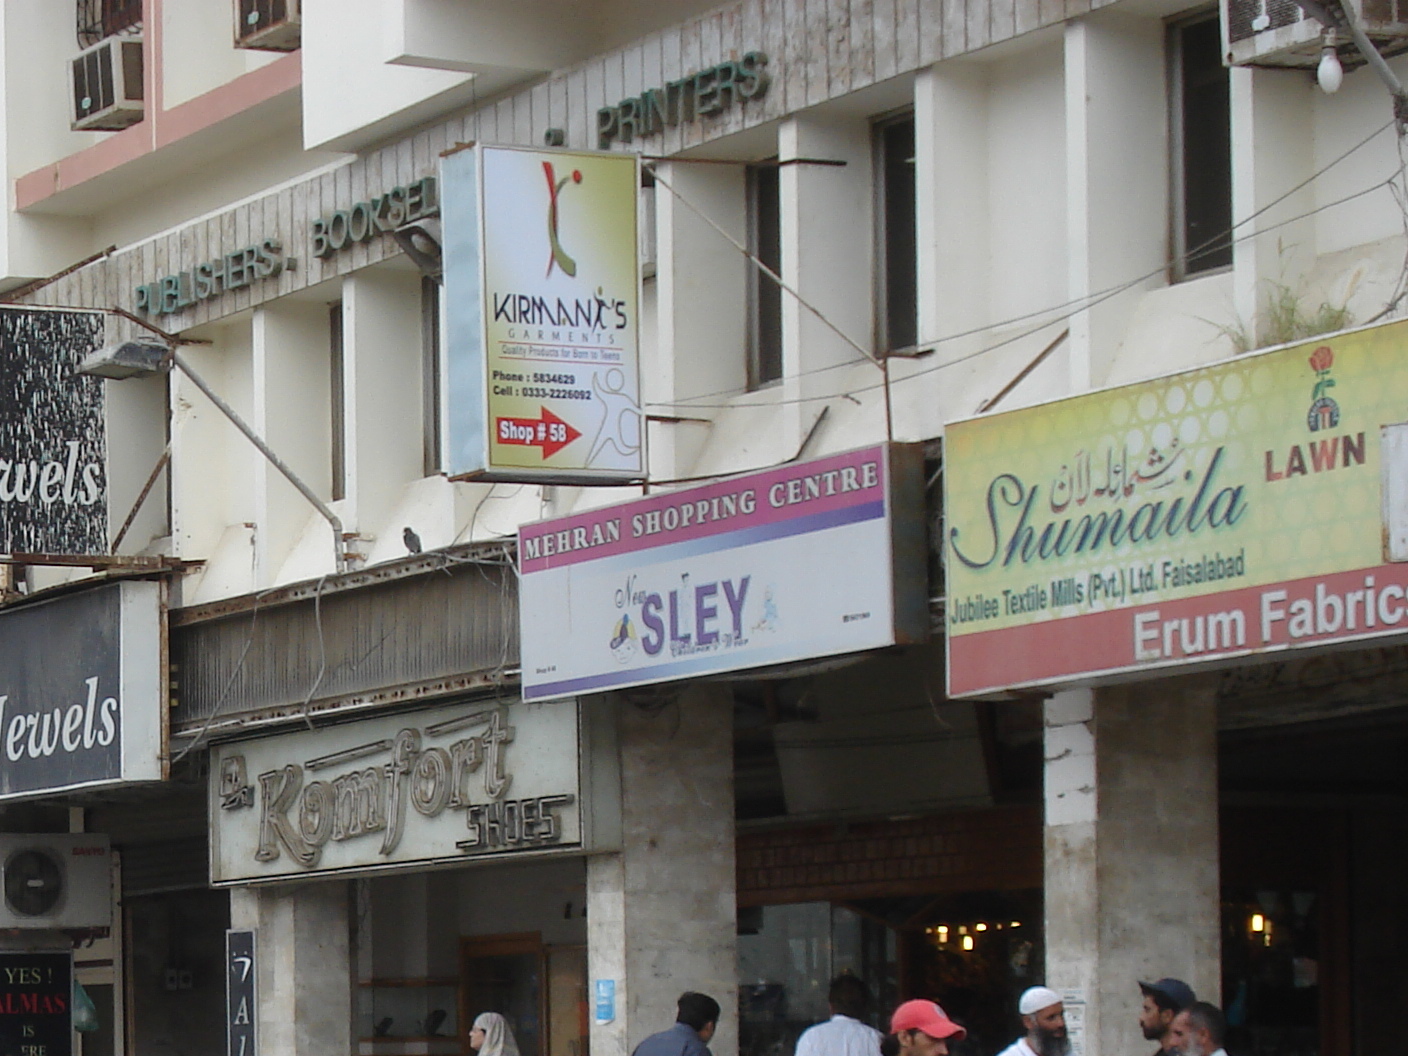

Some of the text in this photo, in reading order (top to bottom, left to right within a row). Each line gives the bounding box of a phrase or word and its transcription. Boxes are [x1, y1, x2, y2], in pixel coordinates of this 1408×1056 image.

[597, 51, 770, 150] PRINTERS
[508, 328, 615, 344] GARMENTS
[492, 370, 523, 382] Phone
[493, 386, 513, 396] Cell
[499, 421, 567, 445] Shop # 58
[1265, 432, 1366, 482] LAWN
[524, 463, 879, 561] MEHRAN SHOPPING CENTRE
[951, 446, 1247, 569] Shumaila
[951, 548, 1245, 624] Jubilee Textile Mills (Pvt.) Ltd. Faisalabad
[641, 574, 751, 655] SLEY
[1134, 575, 1408, 661] Erum Fabric
[255, 707, 514, 867] Komfort
[456, 794, 574, 848] SHOES
[4, 968, 41, 984] YES
[23, 1025, 34, 1037] IS
